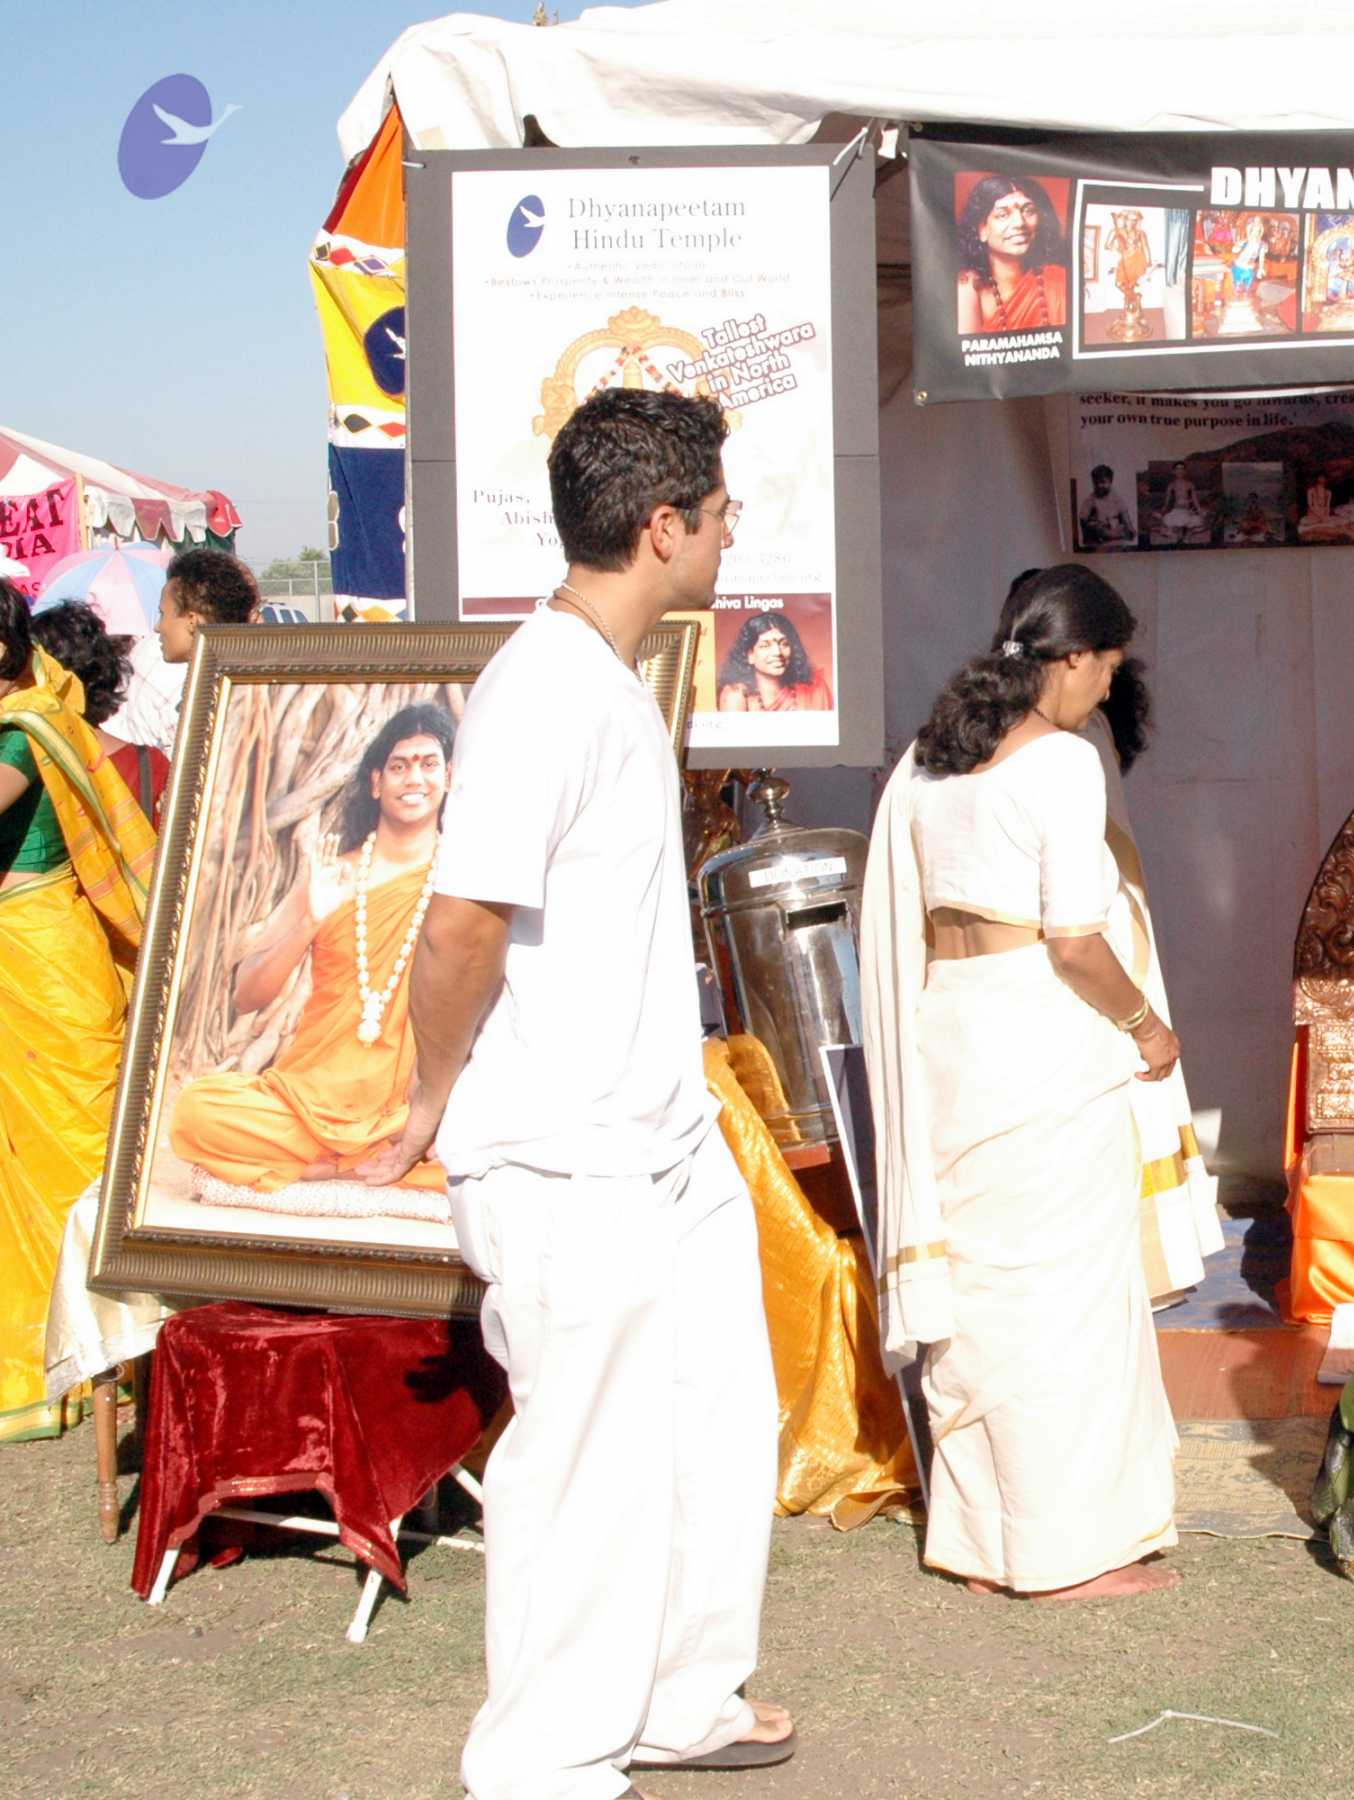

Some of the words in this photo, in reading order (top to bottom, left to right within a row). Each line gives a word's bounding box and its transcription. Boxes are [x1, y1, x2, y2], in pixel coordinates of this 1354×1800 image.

[568, 197, 746, 222] Dhyanapeetam
[573, 228, 644, 250] Hindu
[651, 227, 743, 253] Temple
[961, 331, 1063, 353] PARAMAHAMSA
[964, 345, 1060, 367] NITHYANANDA
[707, 373, 730, 394] in
[729, 350, 792, 386] North
[1080, 414, 1115, 429] your
[1117, 413, 1148, 425] own
[1151, 414, 1181, 427] true
[1184, 416, 1244, 430] purpose
[1247, 412, 1261, 427] in
[473, 489, 530, 507] Pujas,
[711, 595, 742, 610] hiva
[744, 594, 785, 613] Lingas
